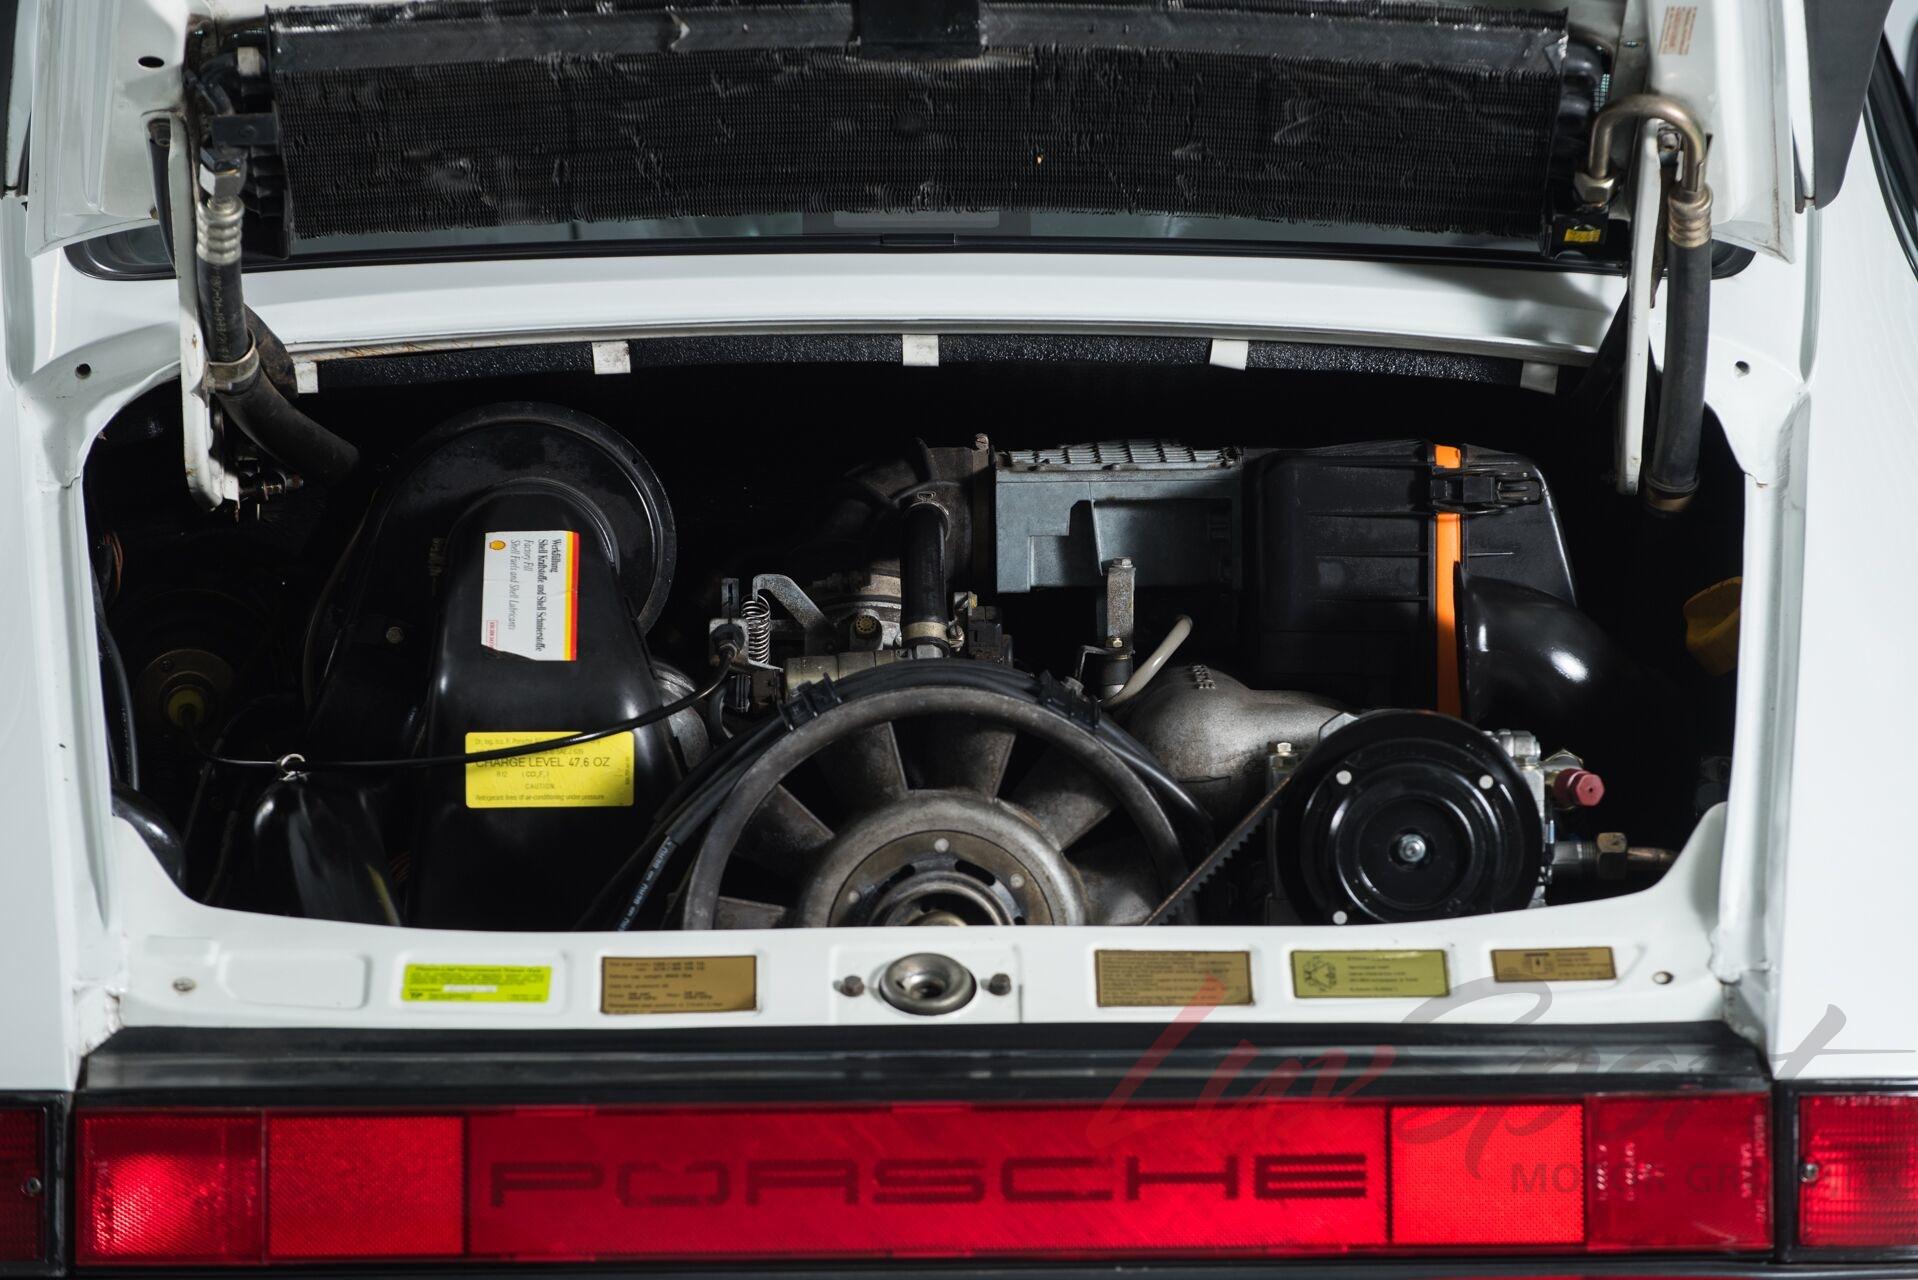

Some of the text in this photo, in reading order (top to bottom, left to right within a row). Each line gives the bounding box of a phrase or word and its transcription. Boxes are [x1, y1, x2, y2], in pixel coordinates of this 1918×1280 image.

[522, 539, 534, 572] Factory Fill
[549, 538, 561, 573] Werkfüllung
[508, 539, 520, 630] Shell Fuels and Shell Lubricants
[536, 539, 548, 652] Shell Kraftstoffe und Shell Schmierstoffe
[476, 757, 611, 768] CHARGE LEVEL 47.6 OZ
[490, 1153, 1368, 1207] PORSCHE
